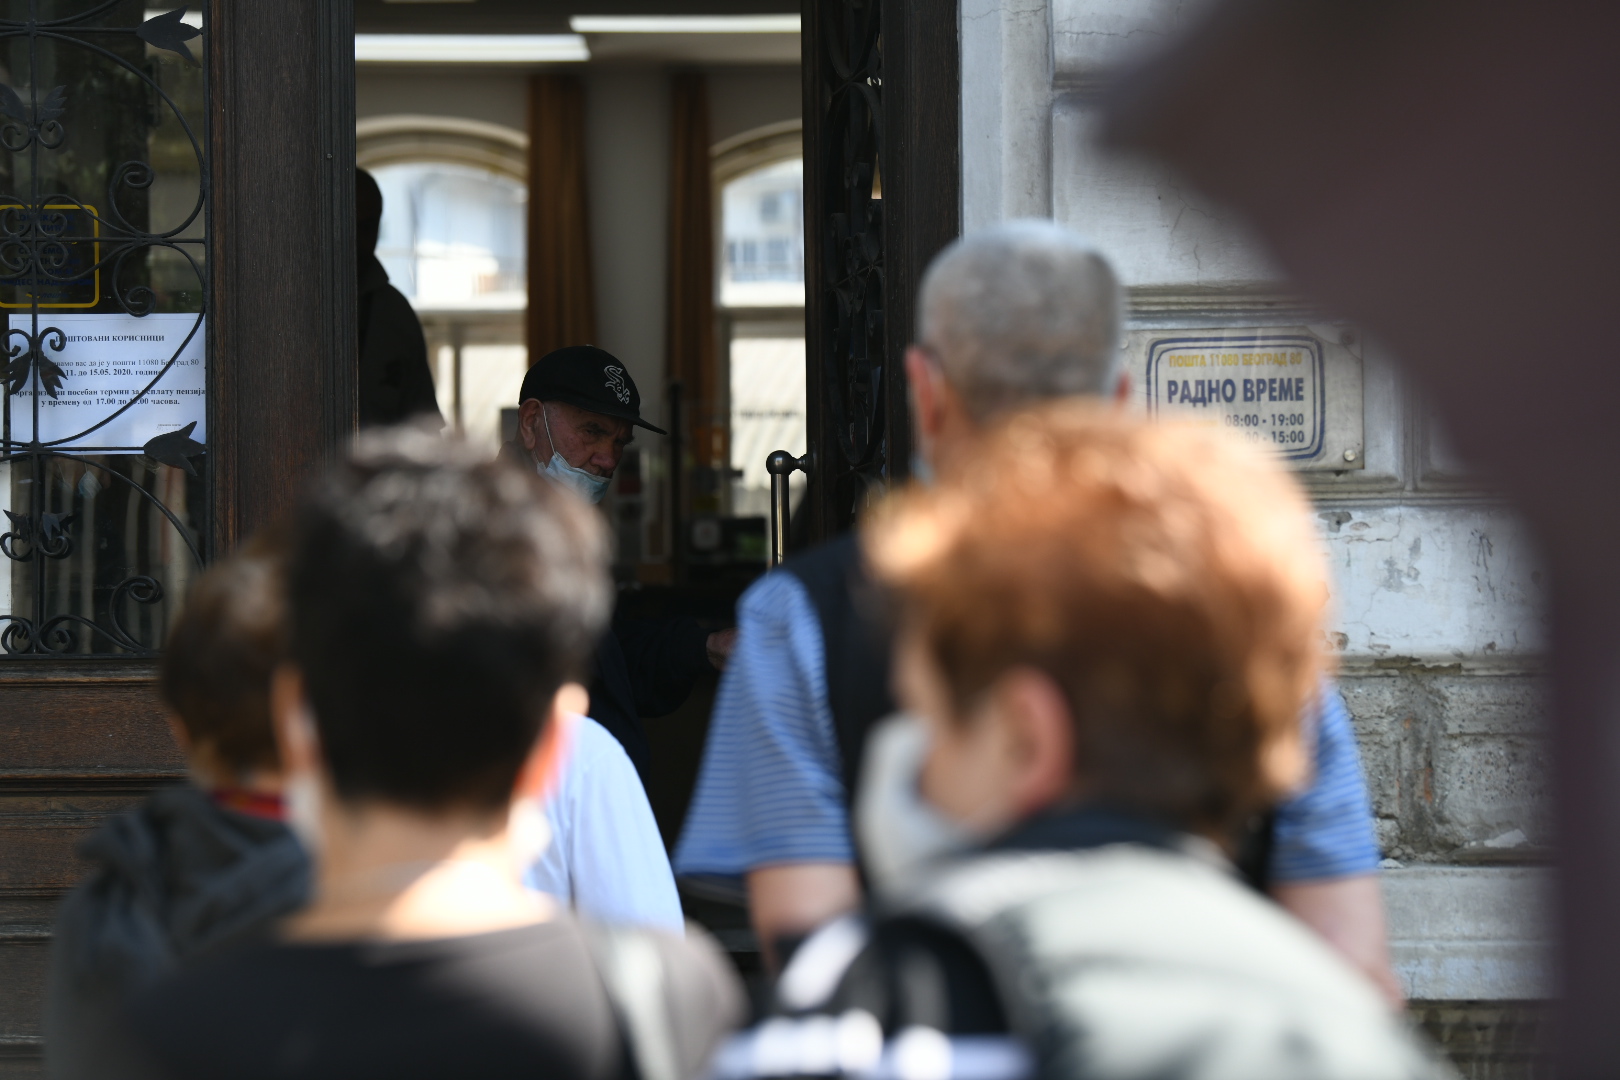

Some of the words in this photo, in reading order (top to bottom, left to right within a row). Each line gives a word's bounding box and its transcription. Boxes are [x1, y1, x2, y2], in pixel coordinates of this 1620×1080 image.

[55, 335, 110, 343] ПШТОВАНИ
[1169, 355, 1207, 368] ПОШТА
[1209, 354, 1239, 367] 11080
[1242, 352, 1287, 367] БЕОГРАД
[1290, 352, 1302, 365] 80
[90, 368, 111, 376] 15.05.
[113, 368, 133, 376] 2020.
[67, 388, 98, 396] посебан
[100, 389, 129, 397] термин
[1167, 379, 1236, 407] РАДНО
[1243, 378, 1304, 402] ВРЕМЕ
[41, 400, 47, 408] у
[48, 399, 81, 407] времену
[1225, 414, 1259, 427] 08:00
[1271, 413, 1304, 426] 19:00
[1271, 430, 1305, 443] 15:00
